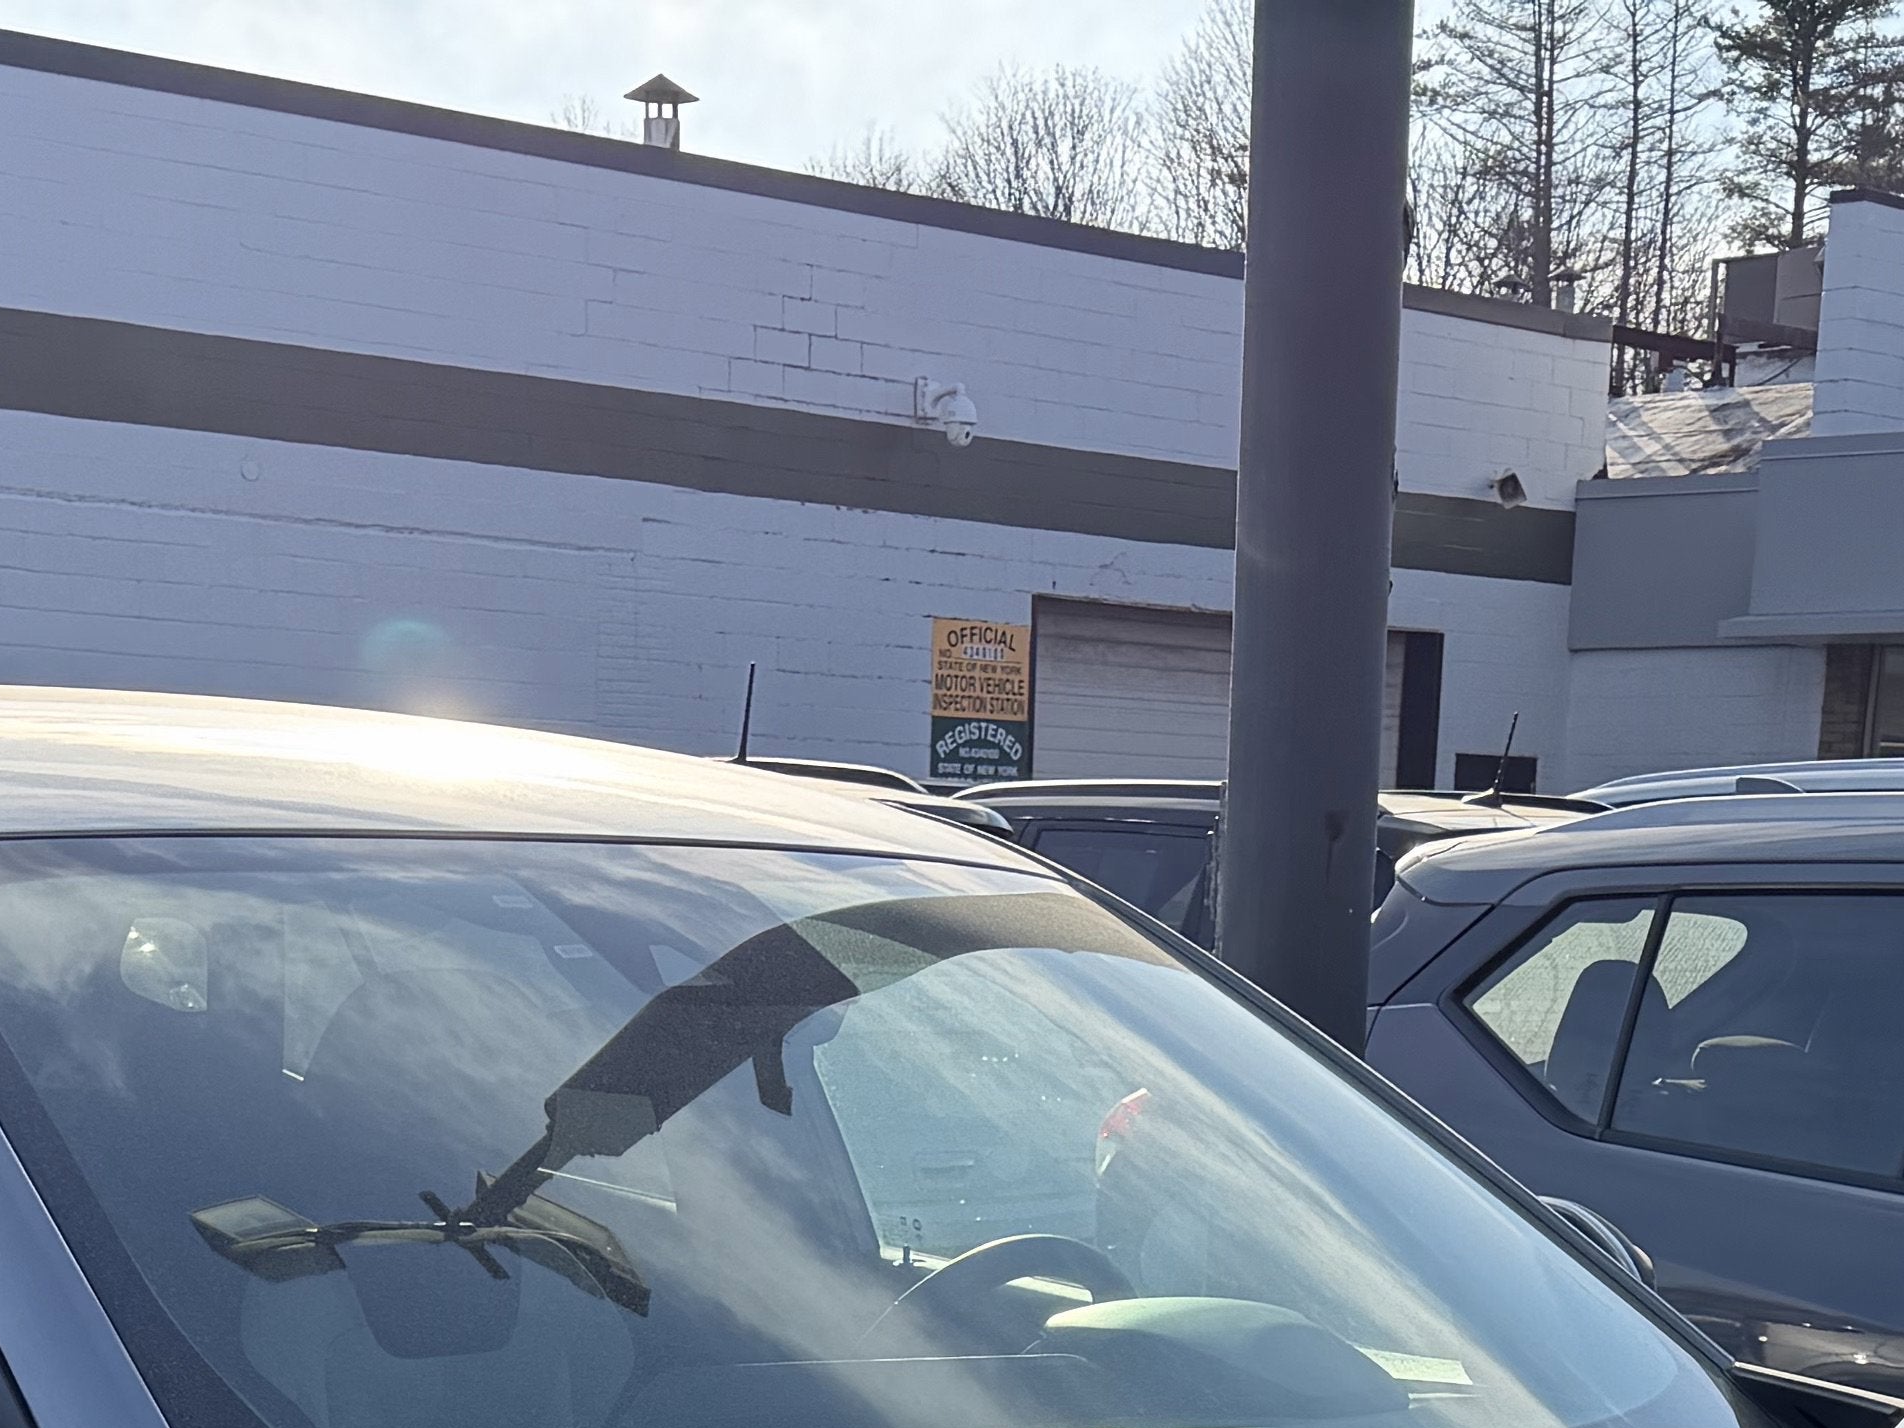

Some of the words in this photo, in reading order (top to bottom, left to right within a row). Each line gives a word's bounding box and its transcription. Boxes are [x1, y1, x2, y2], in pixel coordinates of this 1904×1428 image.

[947, 626, 1016, 652] OFFICIAL
[937, 660, 964, 672] STATE
[966, 662, 977, 672] OF
[979, 663, 997, 674] NEW
[1000, 665, 1022, 675] YORK
[935, 673, 976, 692] MOTOR
[979, 677, 1025, 697] VEHICLE
[933, 693, 988, 714] INSPECTION
[989, 698, 1025, 716] STATION
[936, 722, 1022, 761] REGISTERED
[937, 762, 961, 774] STATE
[963, 764, 975, 774] OF
[977, 765, 996, 776] NEW
[997, 766, 1018, 777] YORK
